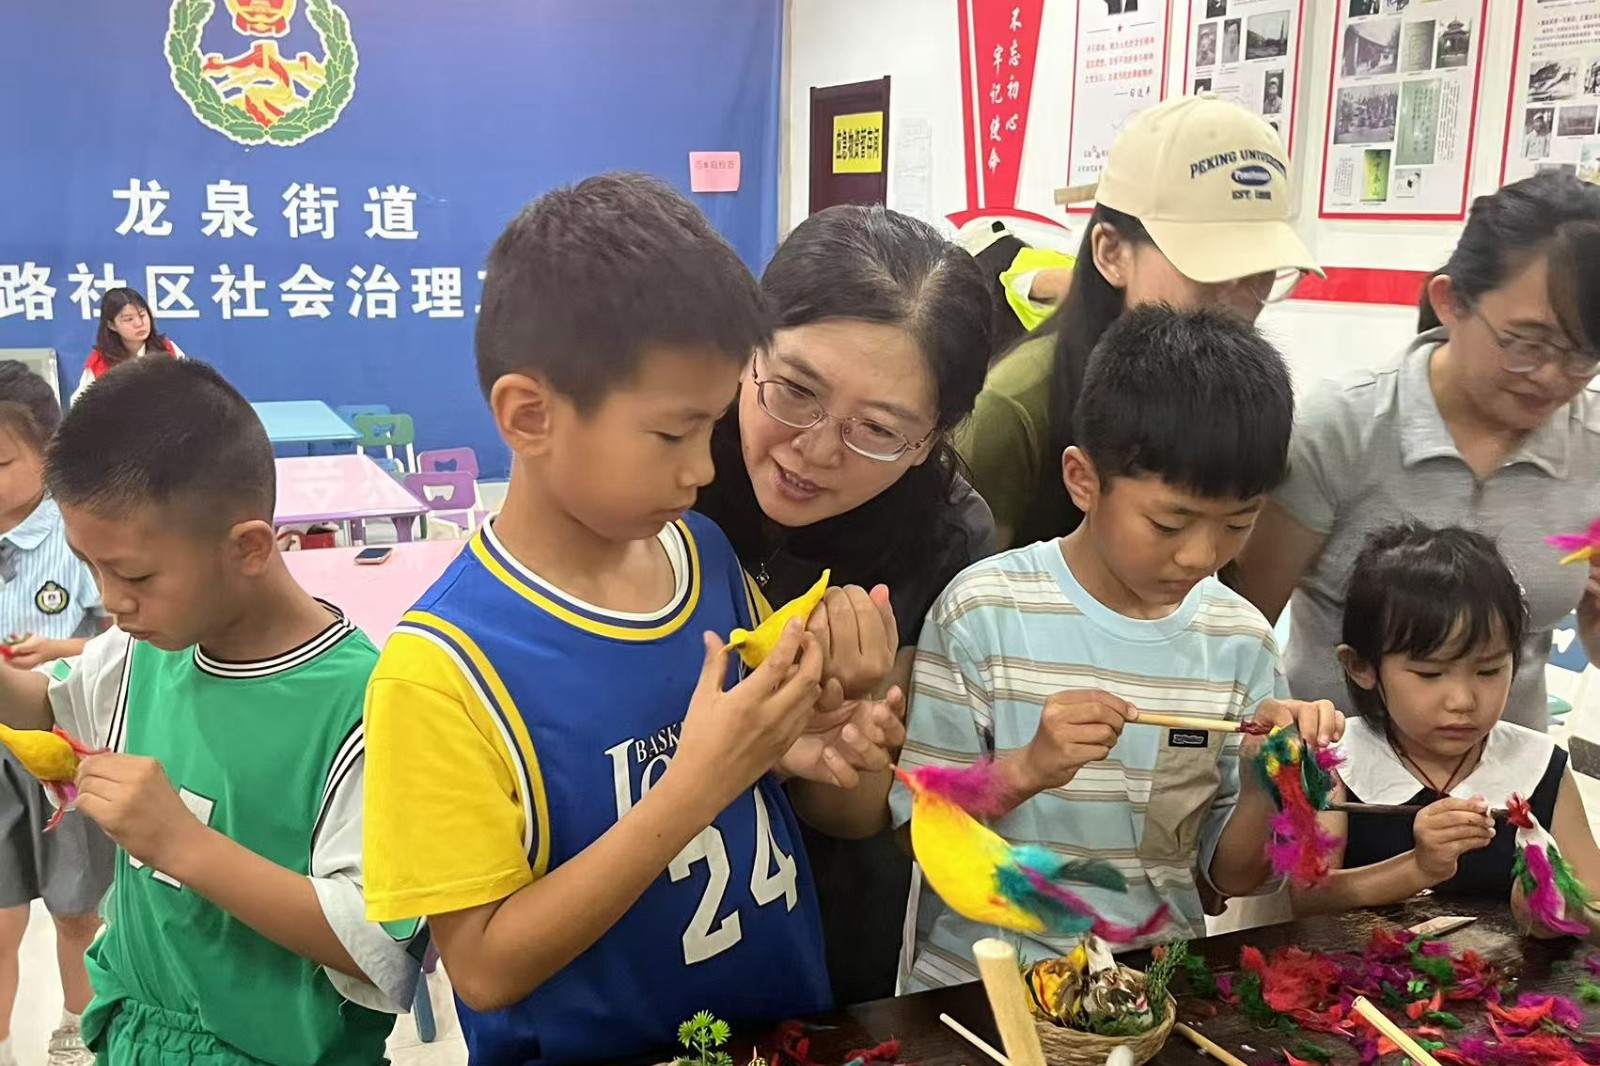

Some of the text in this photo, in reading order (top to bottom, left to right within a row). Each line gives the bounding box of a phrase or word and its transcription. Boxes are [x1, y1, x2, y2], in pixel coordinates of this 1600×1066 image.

[1005, 7, 1022, 131] 不忘初心
[987, 44, 1004, 175] 牢记使命
[1190, 151, 1237, 179] PEKING
[112, 178, 419, 240] 龙泉街道
[0, 261, 487, 320] 路社区社会治理
[635, 722, 684, 764] BASK
[667, 785, 798, 965] 24
